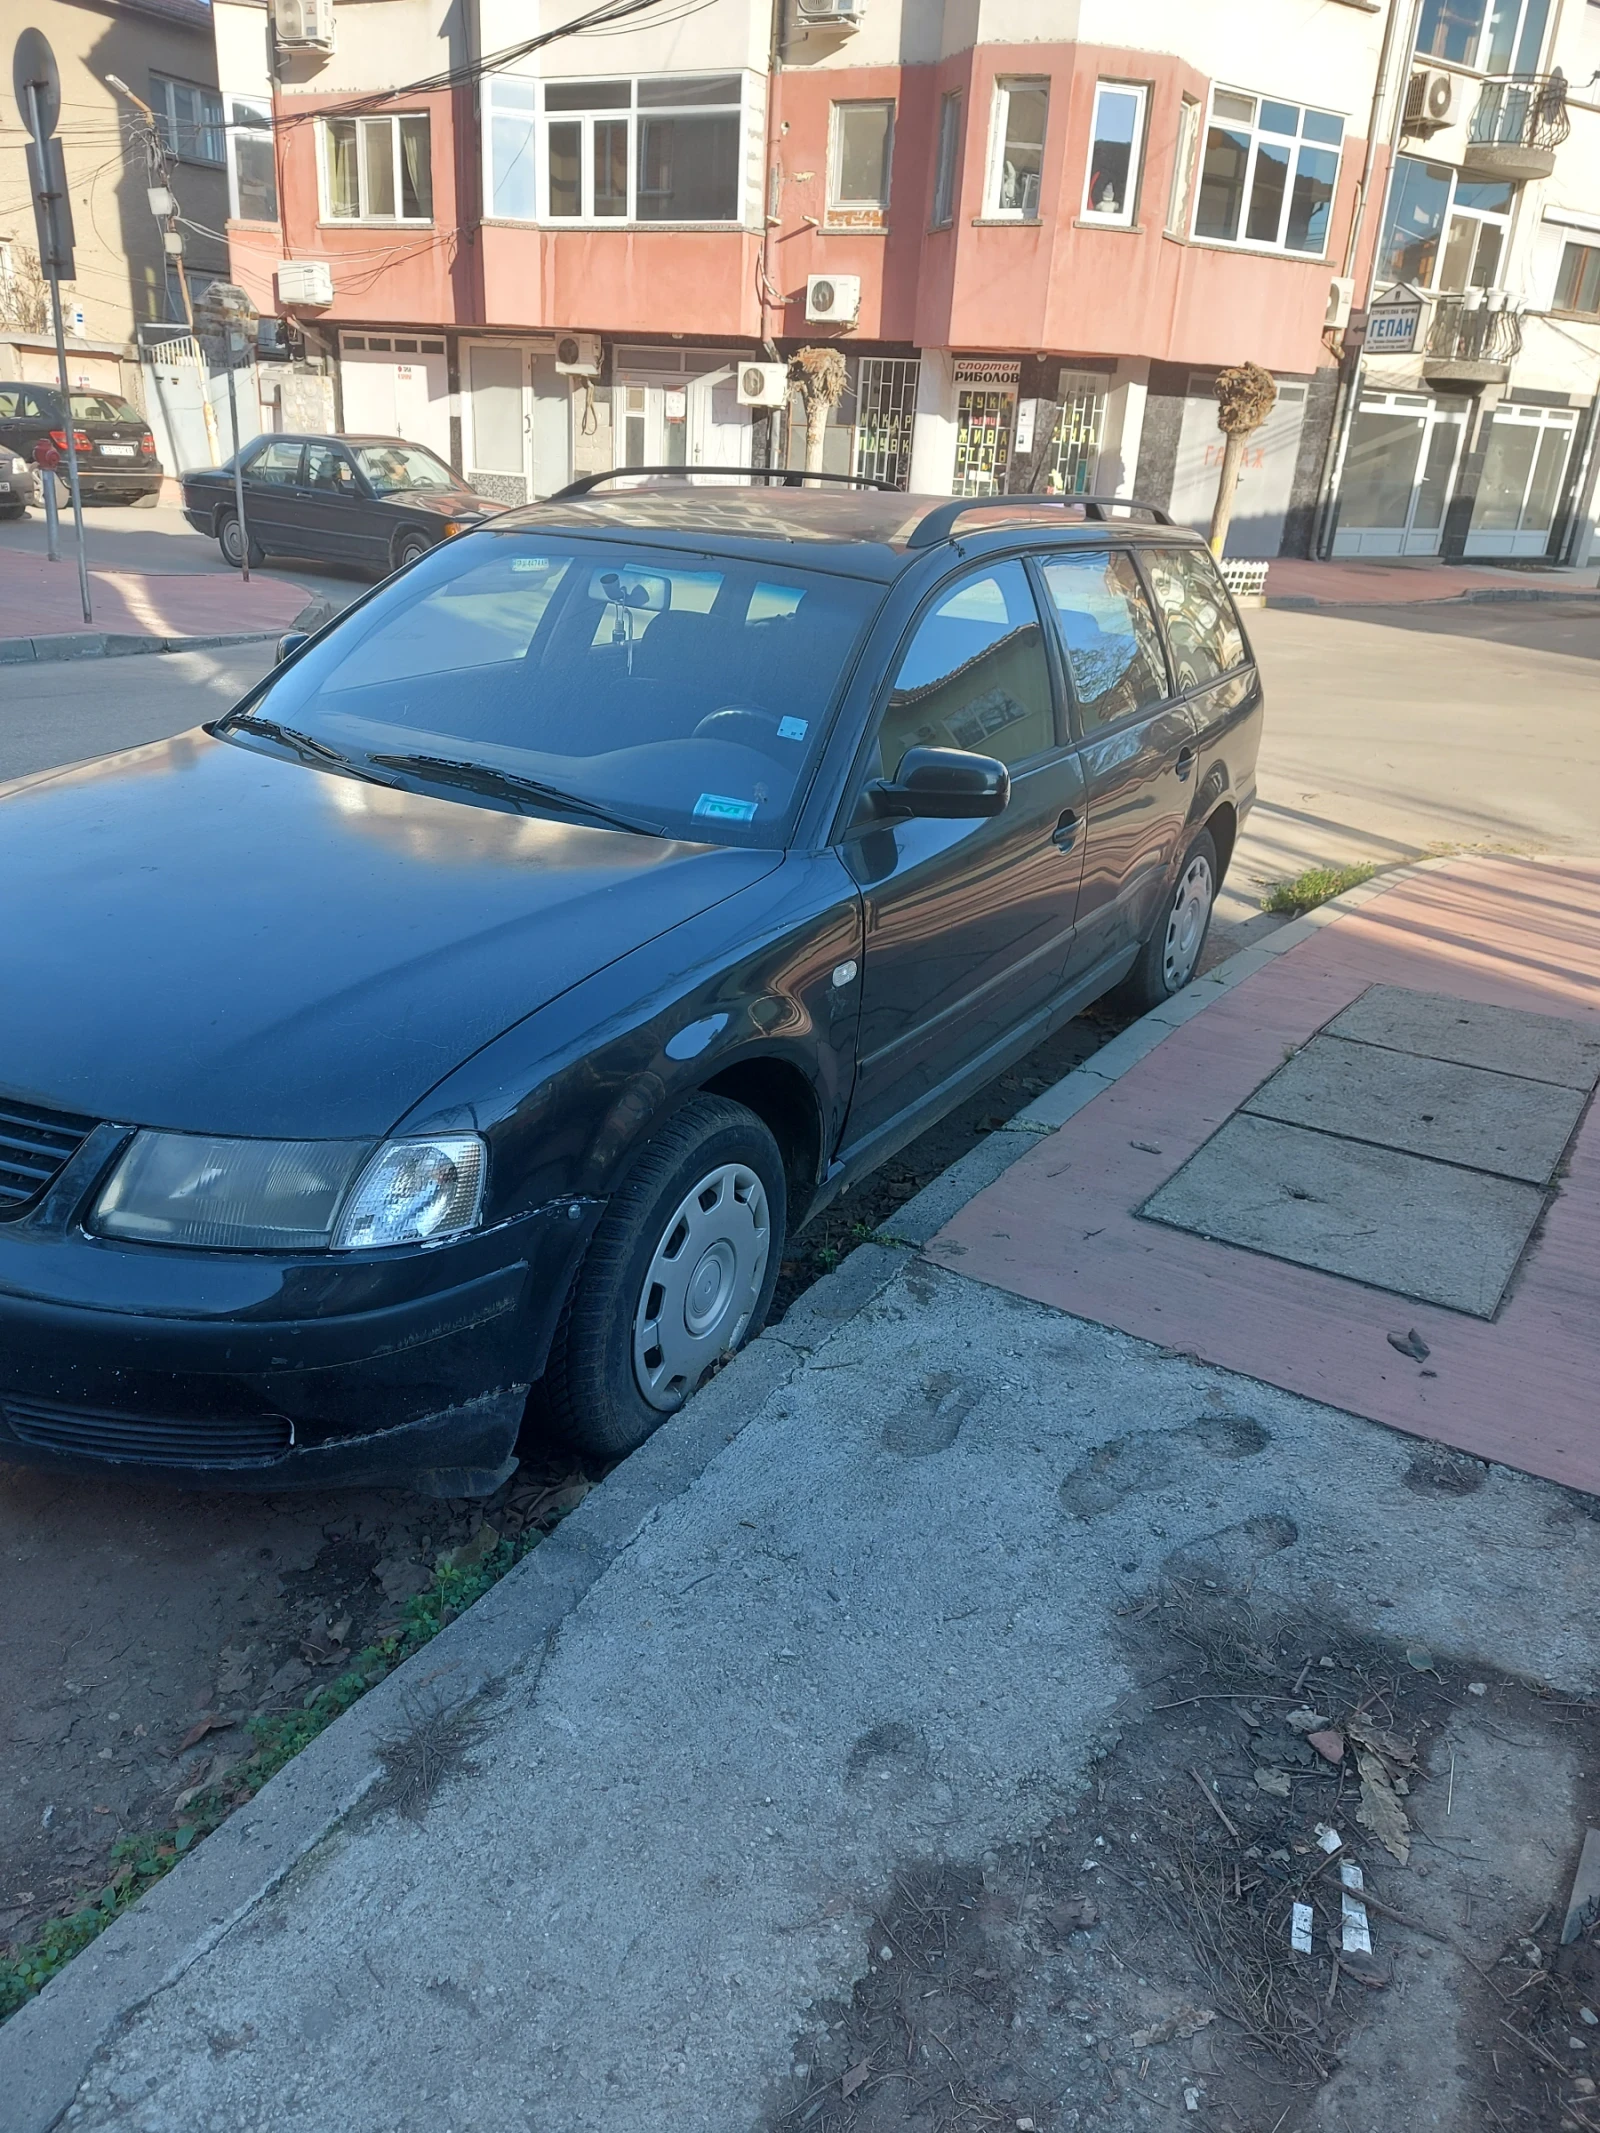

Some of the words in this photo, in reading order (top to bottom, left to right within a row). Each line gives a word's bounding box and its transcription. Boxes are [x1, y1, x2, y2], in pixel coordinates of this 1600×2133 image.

[1369, 318, 1414, 337] ГЕПАН
[954, 371, 1020, 383] РИБОЛОВ
[965, 395, 1008, 409] КУКИ
[859, 436, 911, 454] ПЛУВК
[958, 428, 1008, 445] ЖИВА
[1204, 445, 1265, 469] ГААЖ
